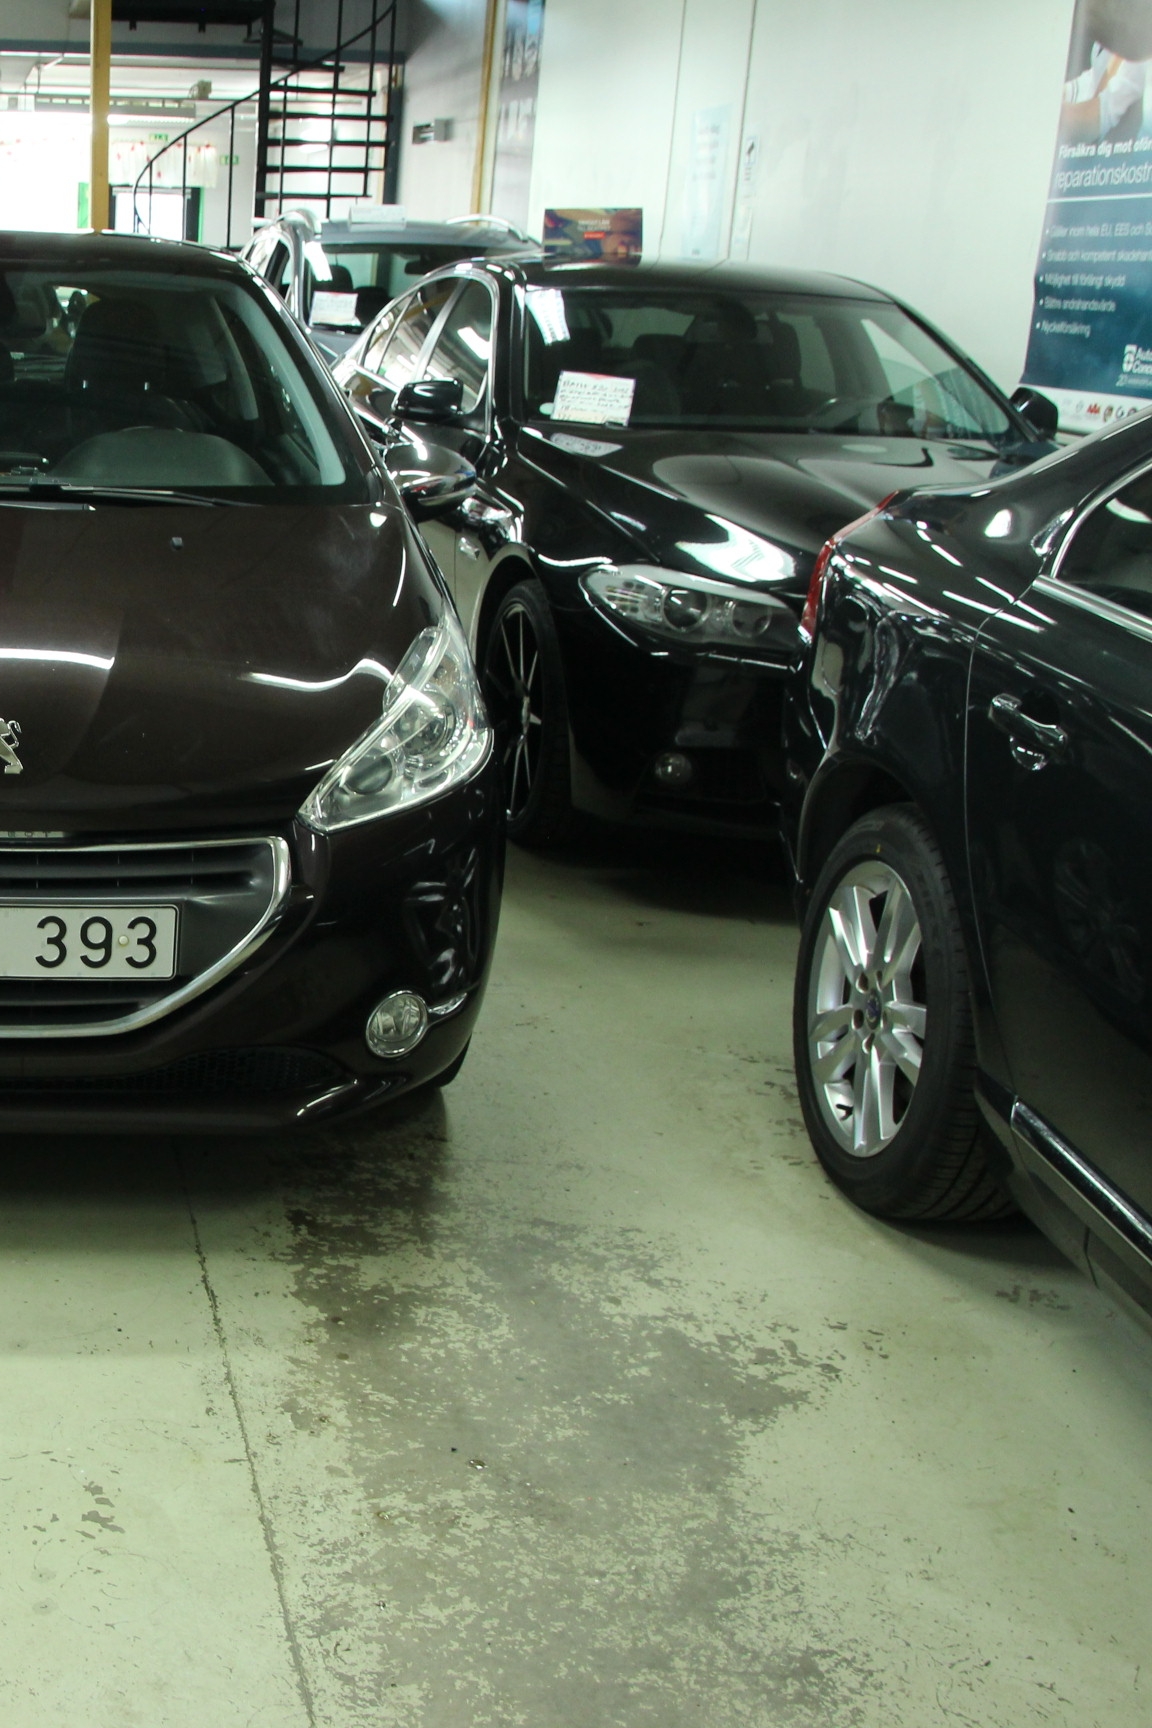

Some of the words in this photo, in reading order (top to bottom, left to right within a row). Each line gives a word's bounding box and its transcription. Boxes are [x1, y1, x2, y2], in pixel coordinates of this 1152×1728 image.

[1097, 141, 1113, 157] dig
[1113, 139, 1133, 154] mot
[35, 915, 157, 969] 393
